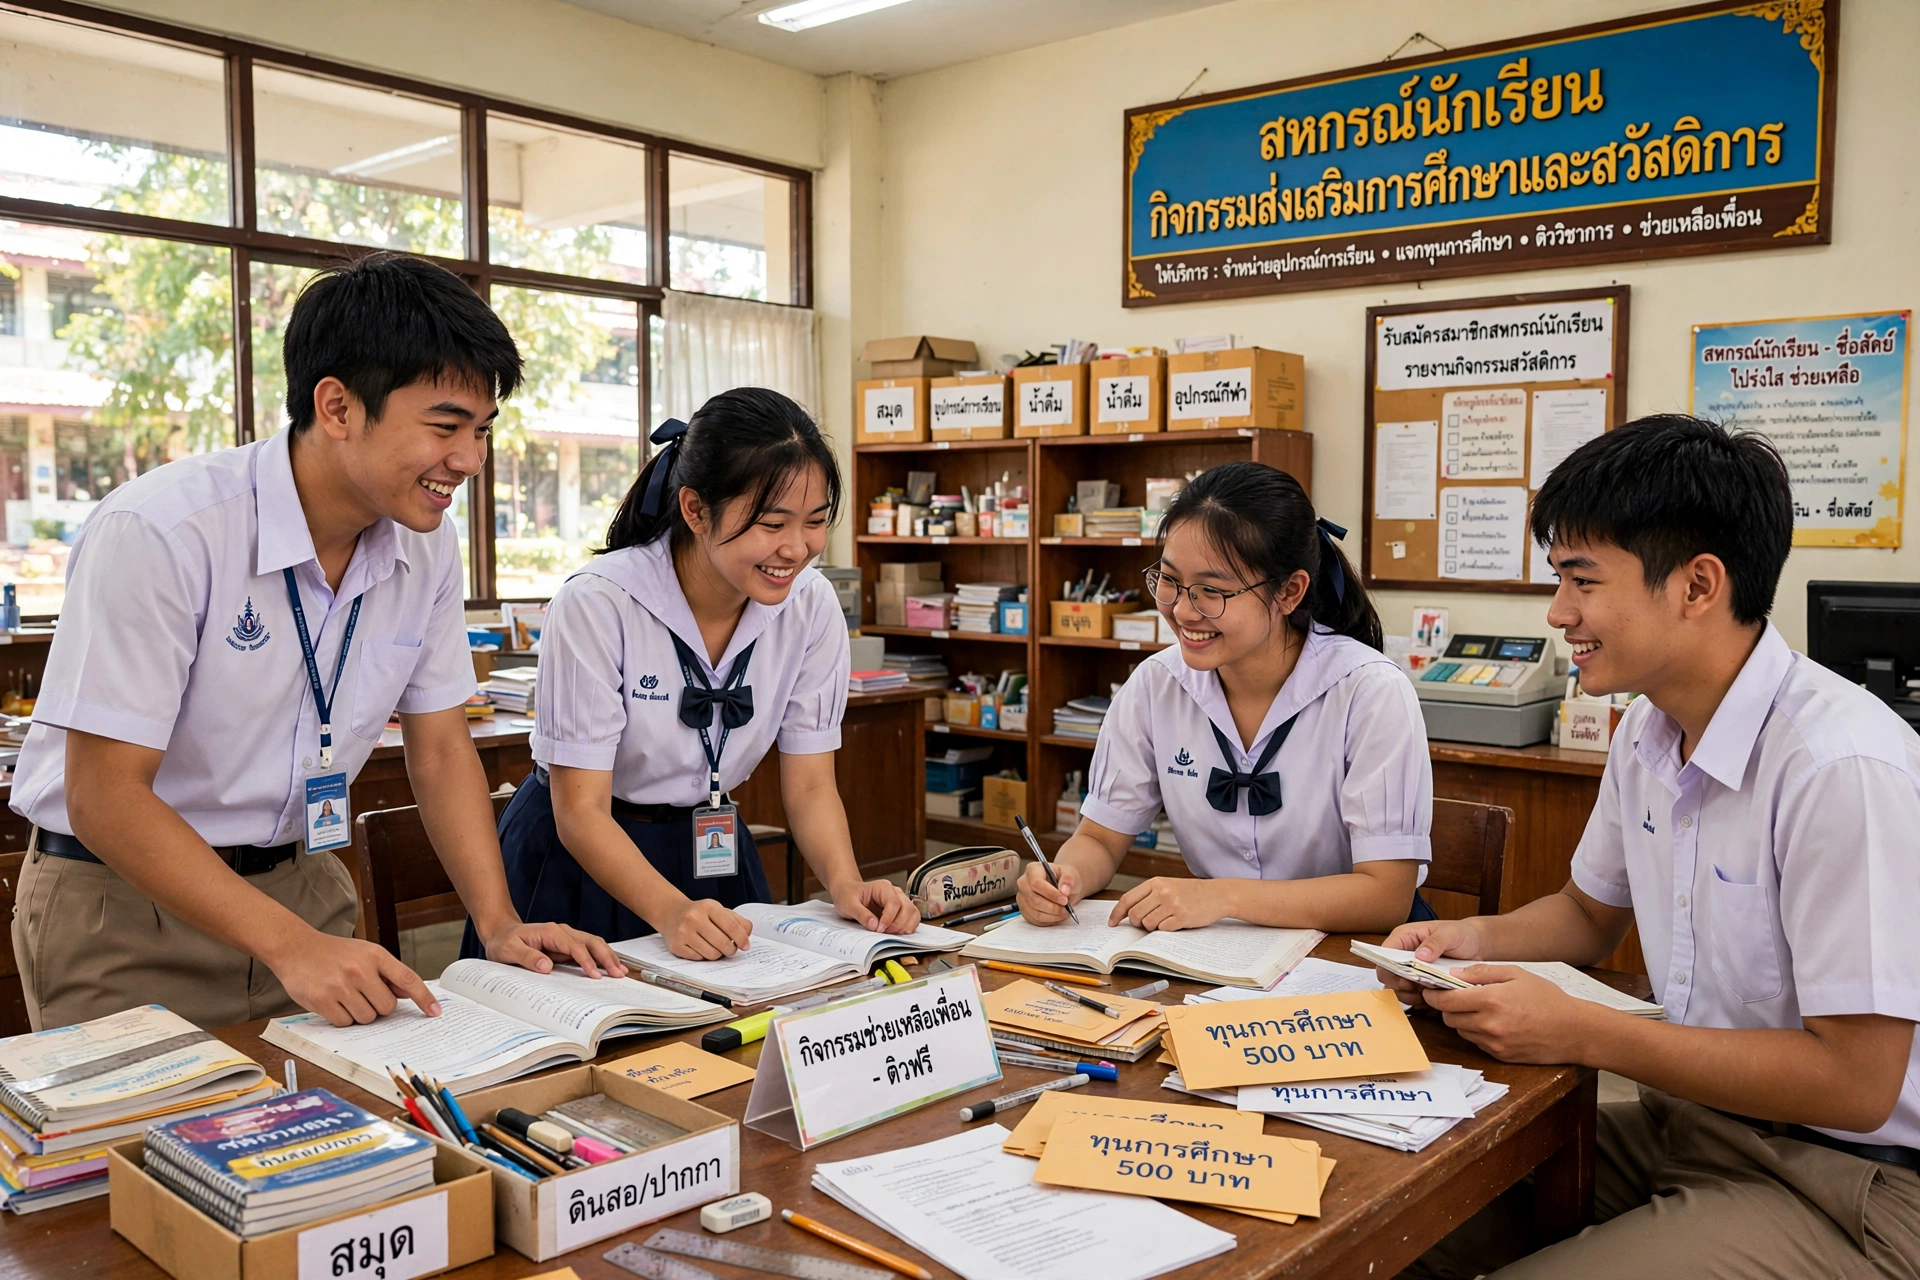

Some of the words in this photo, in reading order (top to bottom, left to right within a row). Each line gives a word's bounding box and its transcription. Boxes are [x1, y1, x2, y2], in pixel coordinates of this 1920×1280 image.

[1259, 57, 1604, 161] สหกรณ์นักเรียน
[1149, 115, 1785, 238] กิจกรรมส่งเสริมการศึกษาและสวัสดิการ
[1155, 263, 1209, 284] ให้บริการ
[1222, 244, 1376, 281] จำหน่ายอุปกรณ์การเรียน
[1395, 228, 1512, 266] แจกทุนการศึกษา
[1639, 196, 1763, 237] ช่วยเหลือเพื่อน
[1383, 311, 1604, 347] รับสมัครสมาชิกสหกรณ์นักเรียน
[1404, 350, 1577, 378] รายงานกิจกรรมสวัสดิการ
[1703, 337, 1820, 362] สหกรณ์นักเรียน
[1789, 363, 1860, 388] ช่วยเหลือ
[876, 403, 904, 426] สมุด
[1029, 387, 1063, 413] น้ำดื่ม
[799, 987, 973, 1067] กิจกรรมช่วยเหลือเพื่อน
[1205, 1008, 1373, 1048] ทุนการศึกษา
[885, 1044, 933, 1086] ติวฟรี
[1243, 1043, 1296, 1065] 500
[1304, 1040, 1364, 1061] บาท
[1271, 1083, 1433, 1104] ทุนการศึกษา
[1089, 1132, 1274, 1169] ทุนการศึกษา
[568, 1156, 722, 1226] ดินสอ/ปากกา
[1116, 1159, 1173, 1181] 500
[1187, 1167, 1251, 1190] บาท
[330, 1224, 415, 1280] สมุด
